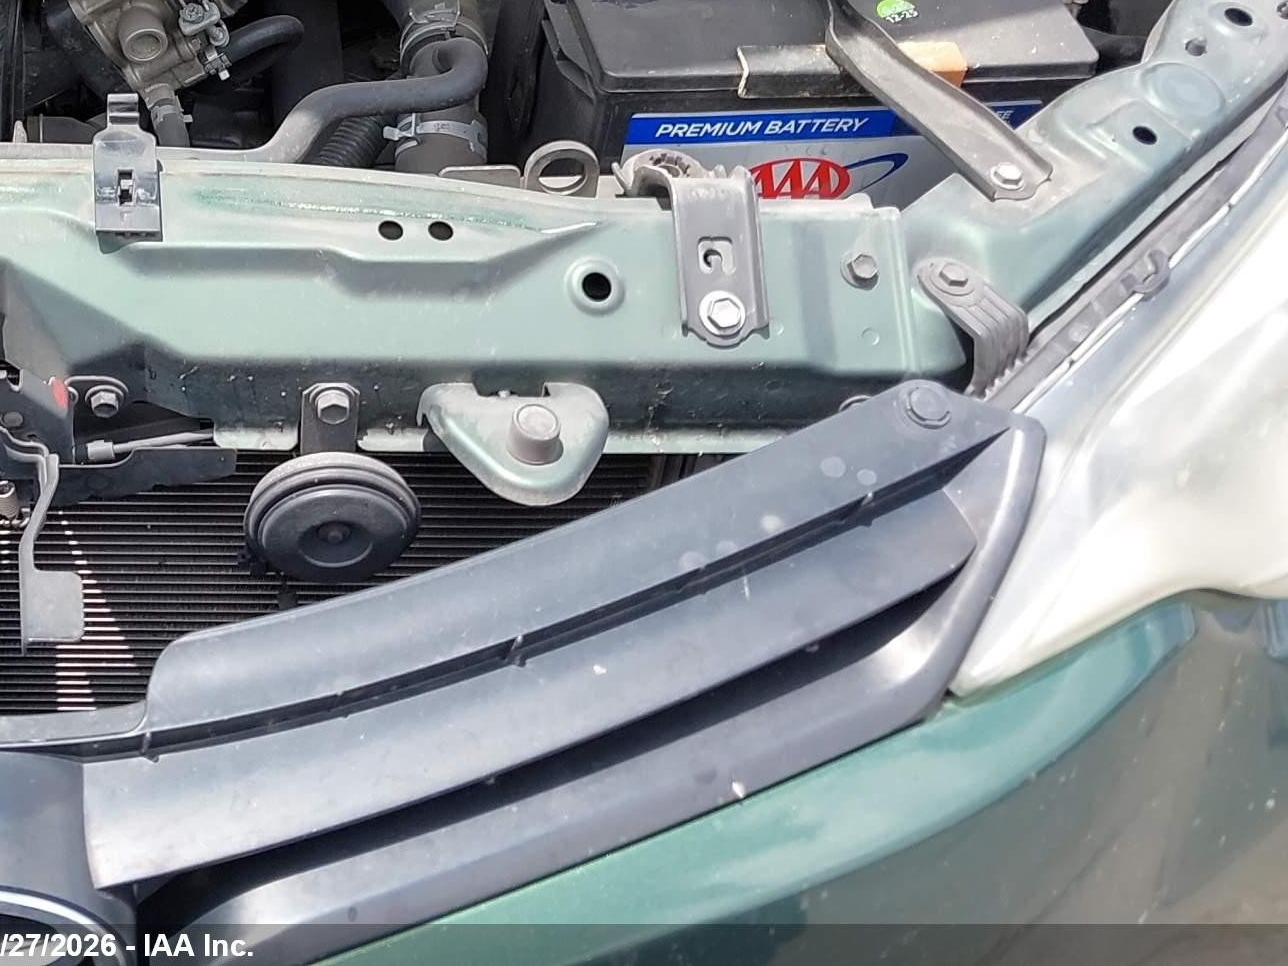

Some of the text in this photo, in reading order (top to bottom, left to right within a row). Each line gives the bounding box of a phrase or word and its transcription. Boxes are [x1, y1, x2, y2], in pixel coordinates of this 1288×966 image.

[655, 117, 870, 138] PREMIUM BATTERY
[752, 159, 845, 199] AAA
